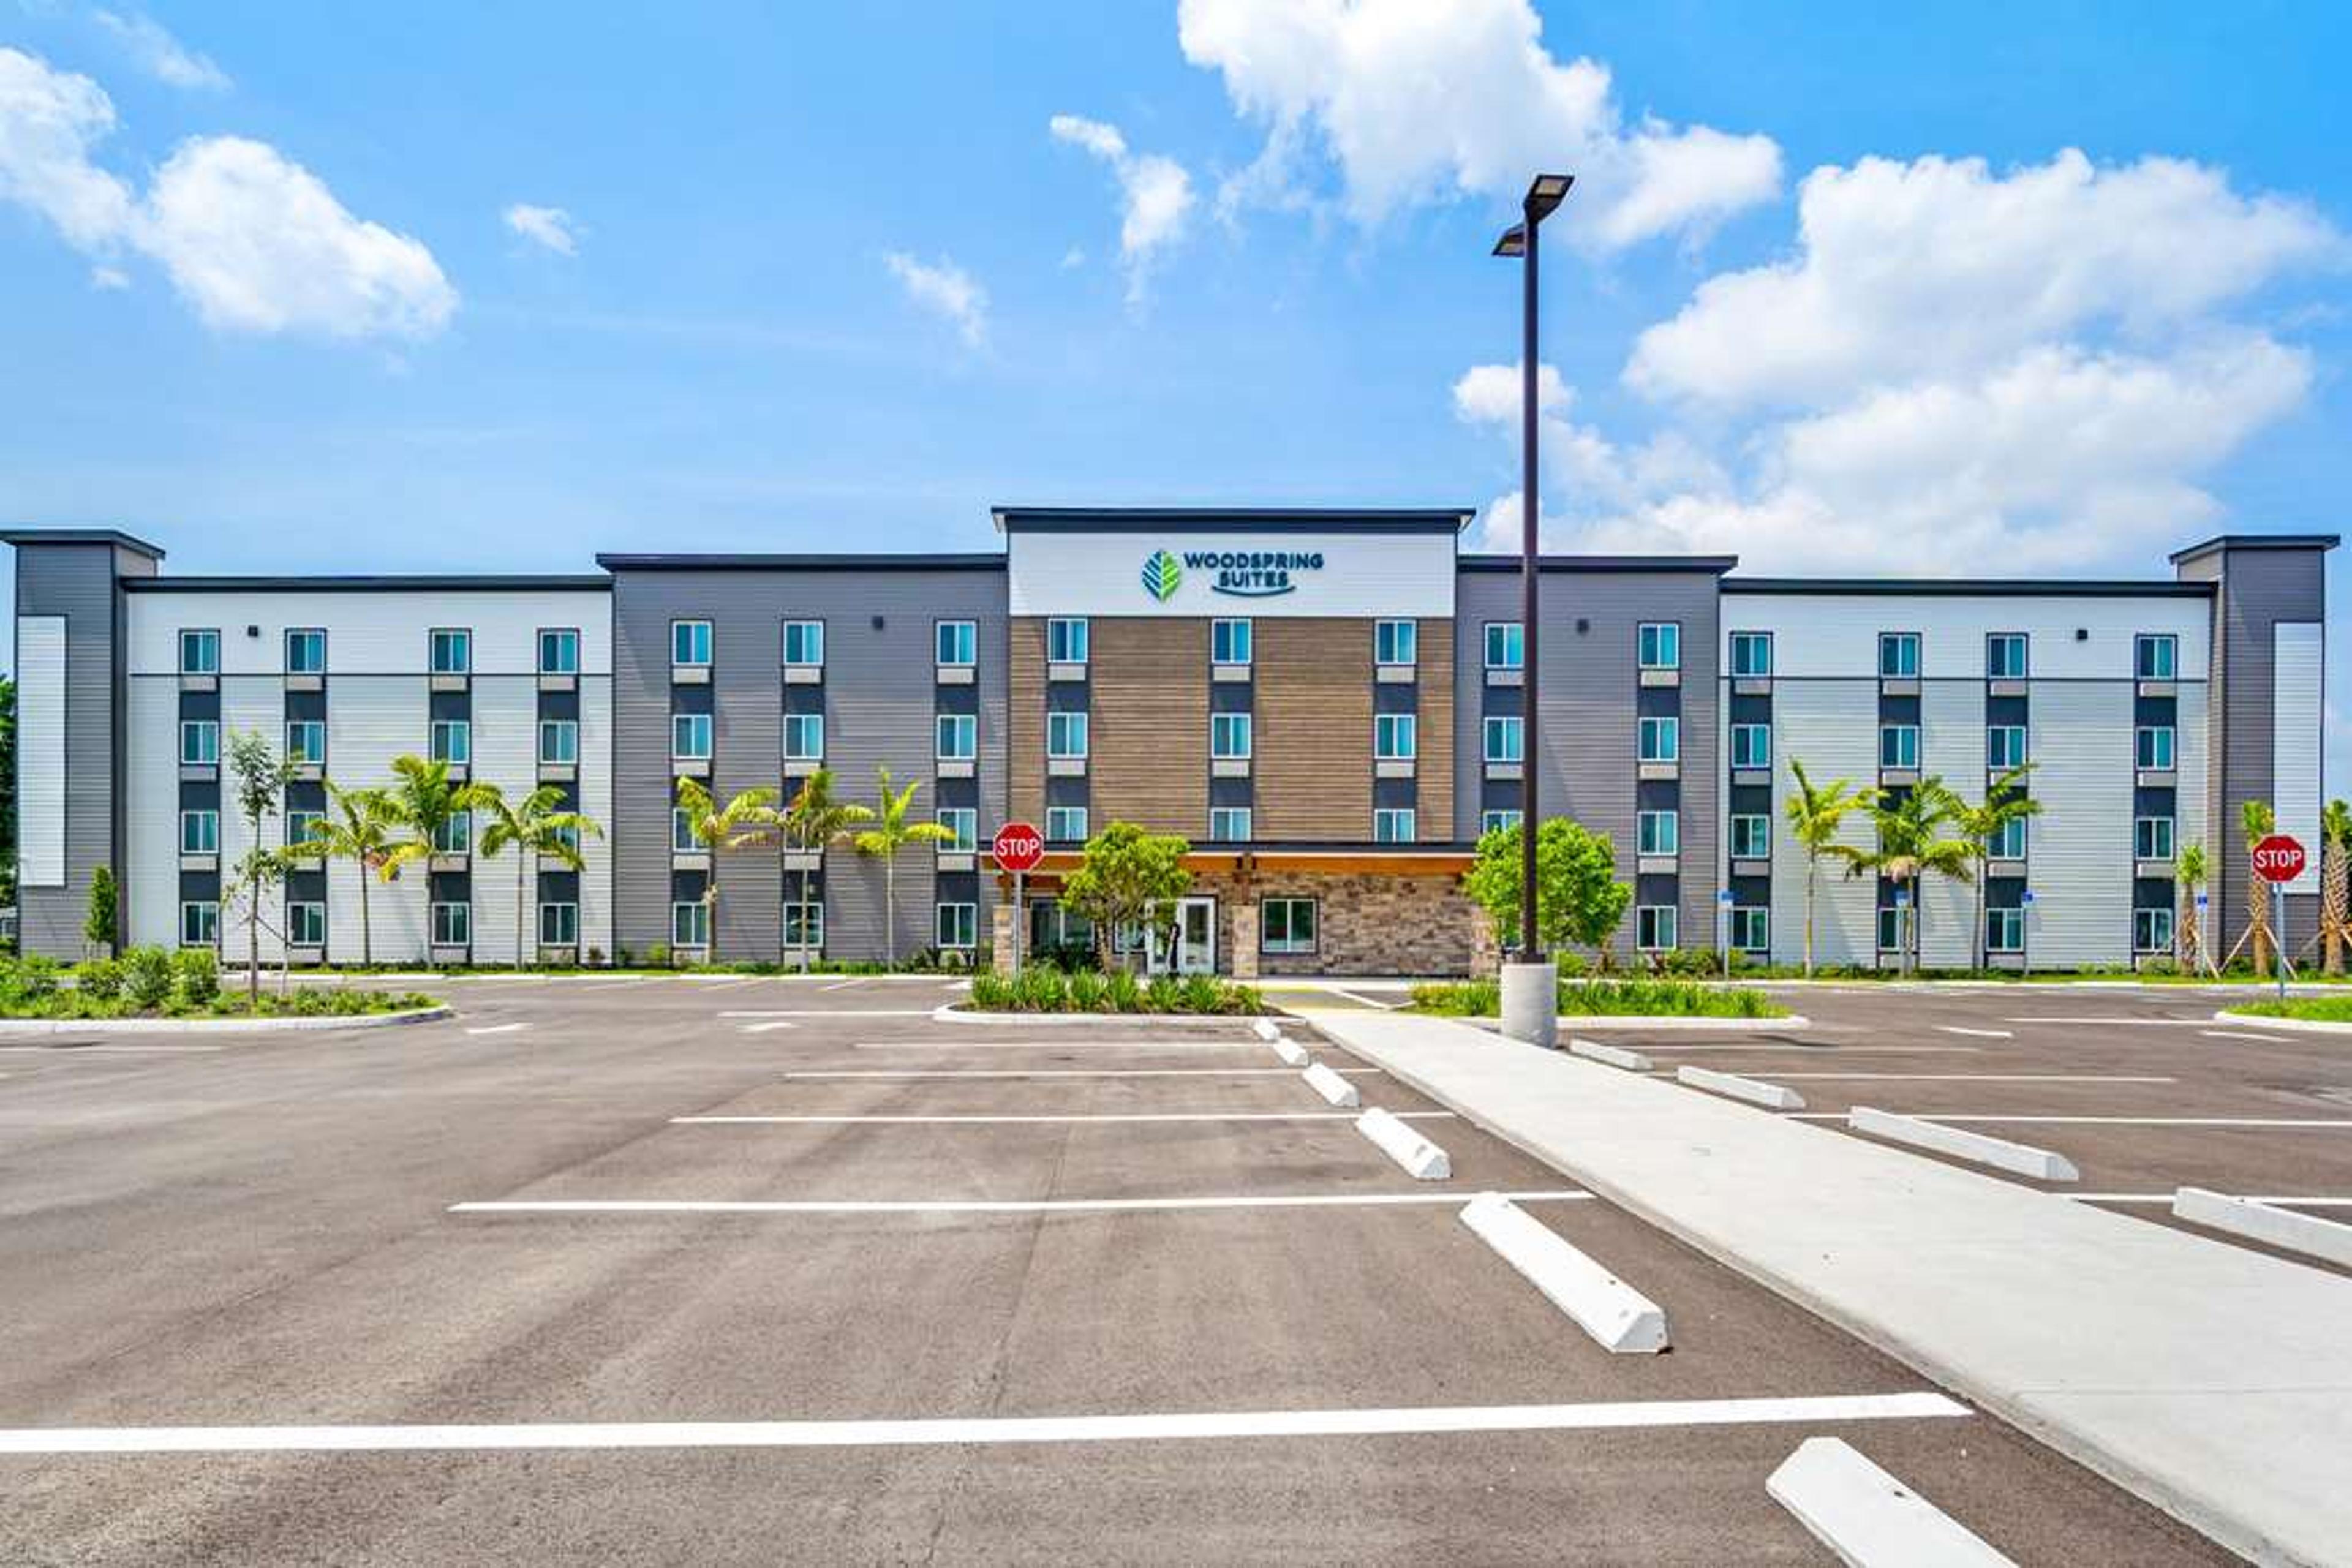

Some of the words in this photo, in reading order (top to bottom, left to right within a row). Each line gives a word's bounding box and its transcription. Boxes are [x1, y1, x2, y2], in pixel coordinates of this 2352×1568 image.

[1183, 552, 1324, 568] WOODSPRING
[1219, 571, 1289, 587] SUITES
[998, 838, 1039, 857] STOP
[2255, 850, 2302, 869] STOP
